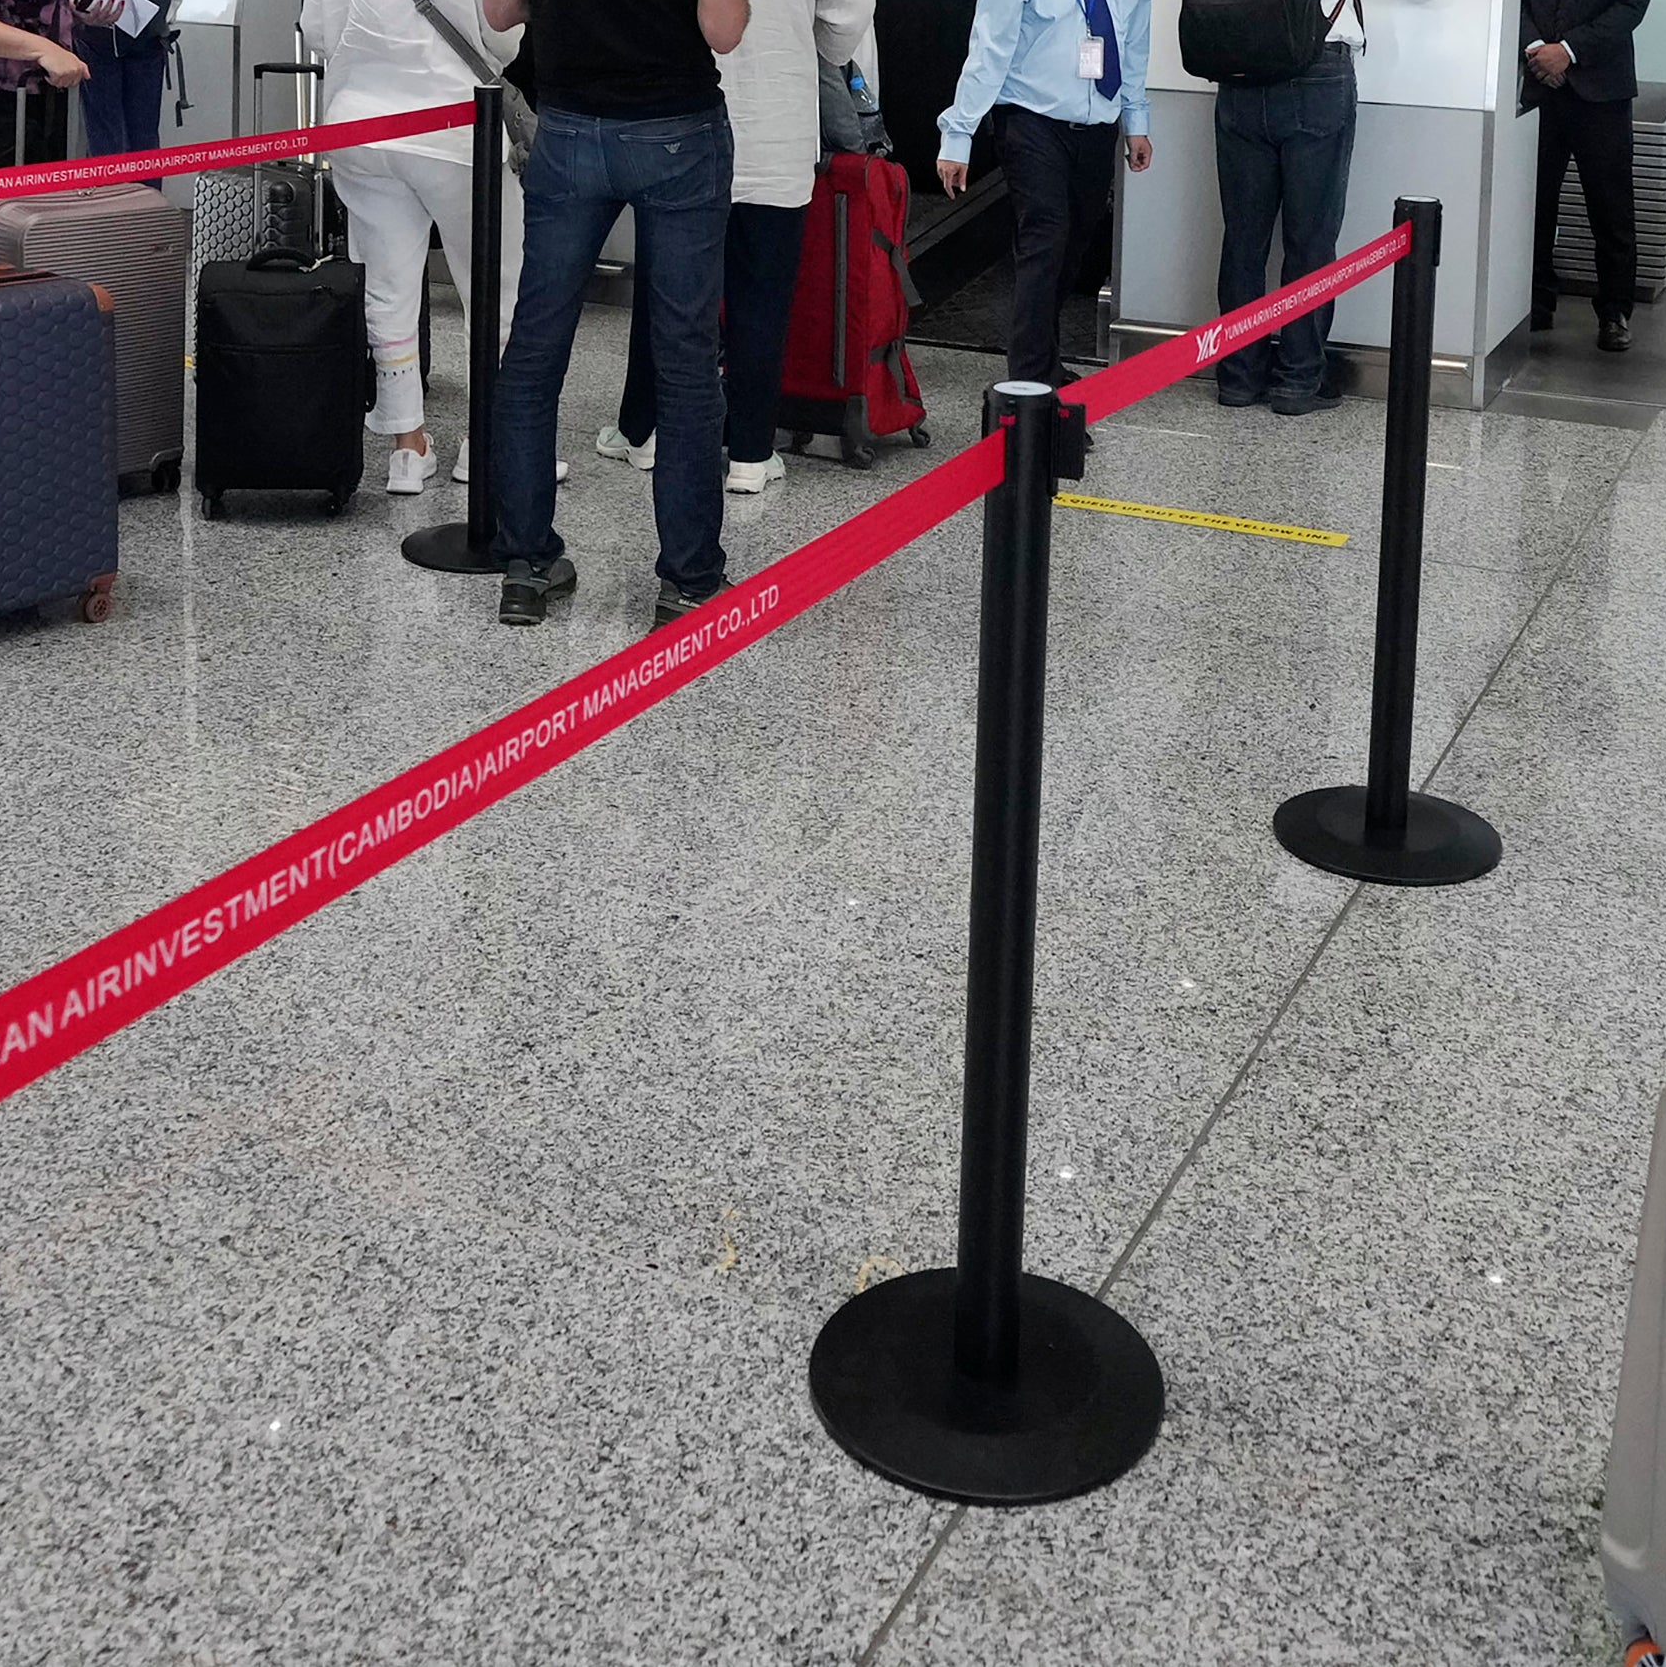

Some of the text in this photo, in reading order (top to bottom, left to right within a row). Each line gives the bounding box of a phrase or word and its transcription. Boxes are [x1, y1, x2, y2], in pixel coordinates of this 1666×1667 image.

[207, 141, 273, 163] MANAGEMENT
[1144, 508, 1177, 518] OUT
[1178, 513, 1200, 521] OF
[1202, 516, 1231, 526] THE
[1234, 521, 1295, 536] YELLOW
[1297, 531, 1333, 541] LINE
[582, 620, 715, 723] MANAGEMENT
